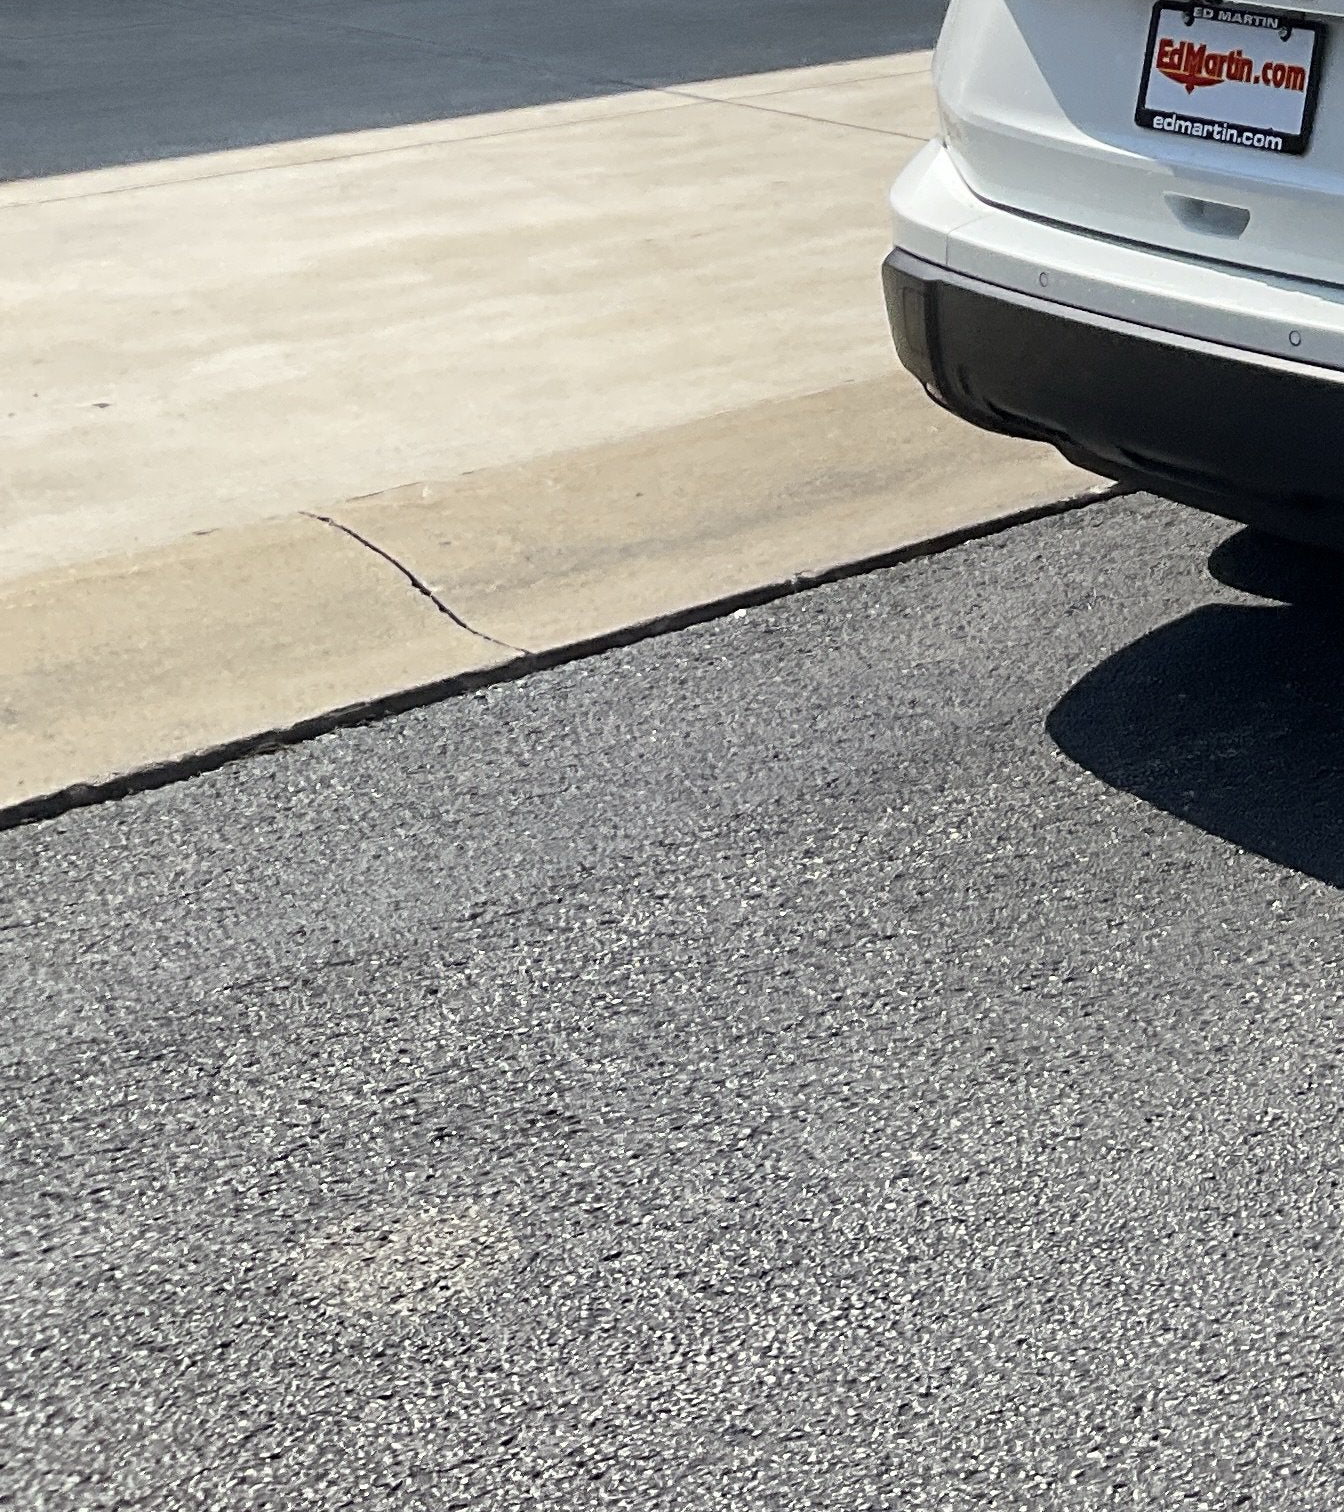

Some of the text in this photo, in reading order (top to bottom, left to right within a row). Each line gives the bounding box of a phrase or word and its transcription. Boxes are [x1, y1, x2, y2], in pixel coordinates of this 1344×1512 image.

[1193, 6, 1279, 29] ED MARTIN
[1156, 38, 1307, 93] EdMartin.com
[1152, 114, 1283, 151] edmartin.com
